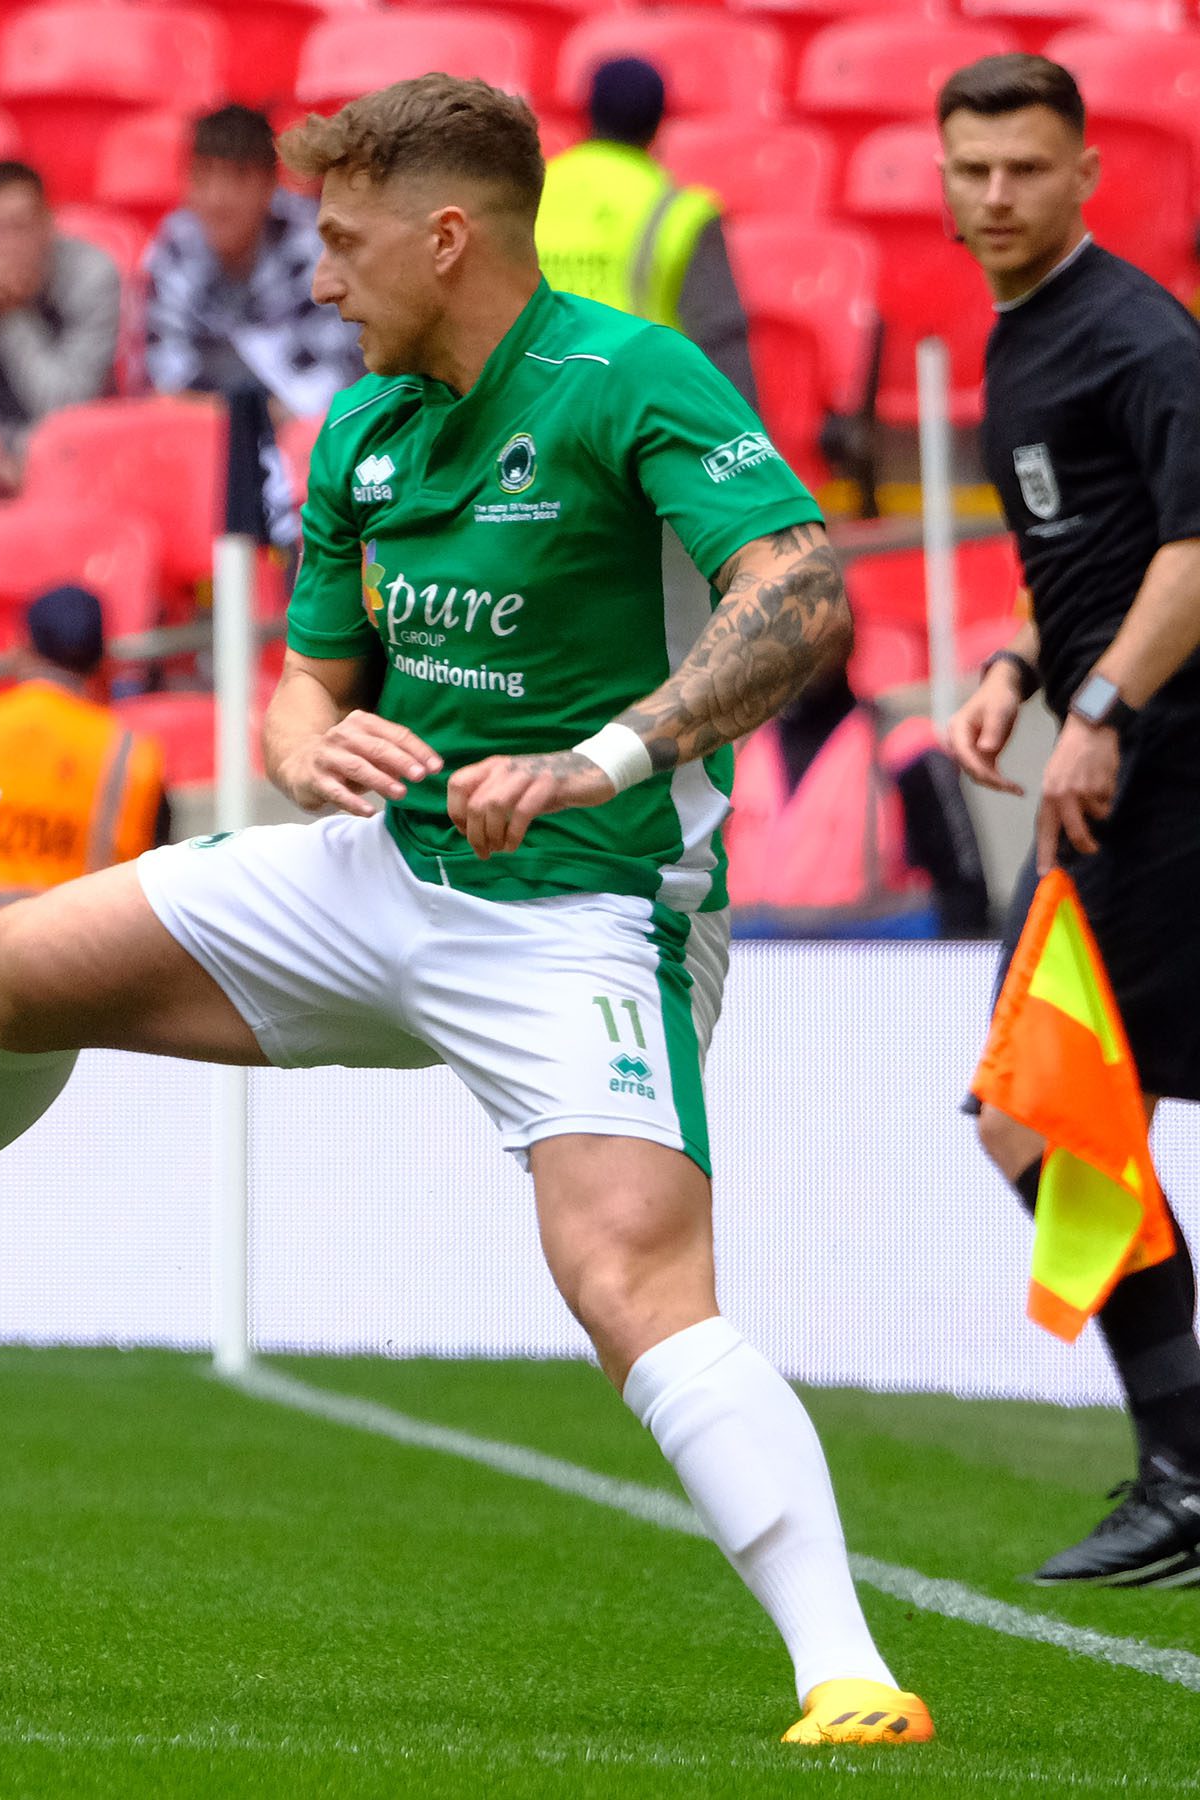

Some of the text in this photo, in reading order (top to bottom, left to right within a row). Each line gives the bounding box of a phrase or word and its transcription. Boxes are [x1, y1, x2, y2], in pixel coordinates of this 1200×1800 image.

[385, 573, 525, 646] pure
[400, 630, 446, 647] GROUP
[388, 647, 525, 697] onditioning
[592, 996, 647, 1049] 11
[609, 1078, 656, 1100] errea
